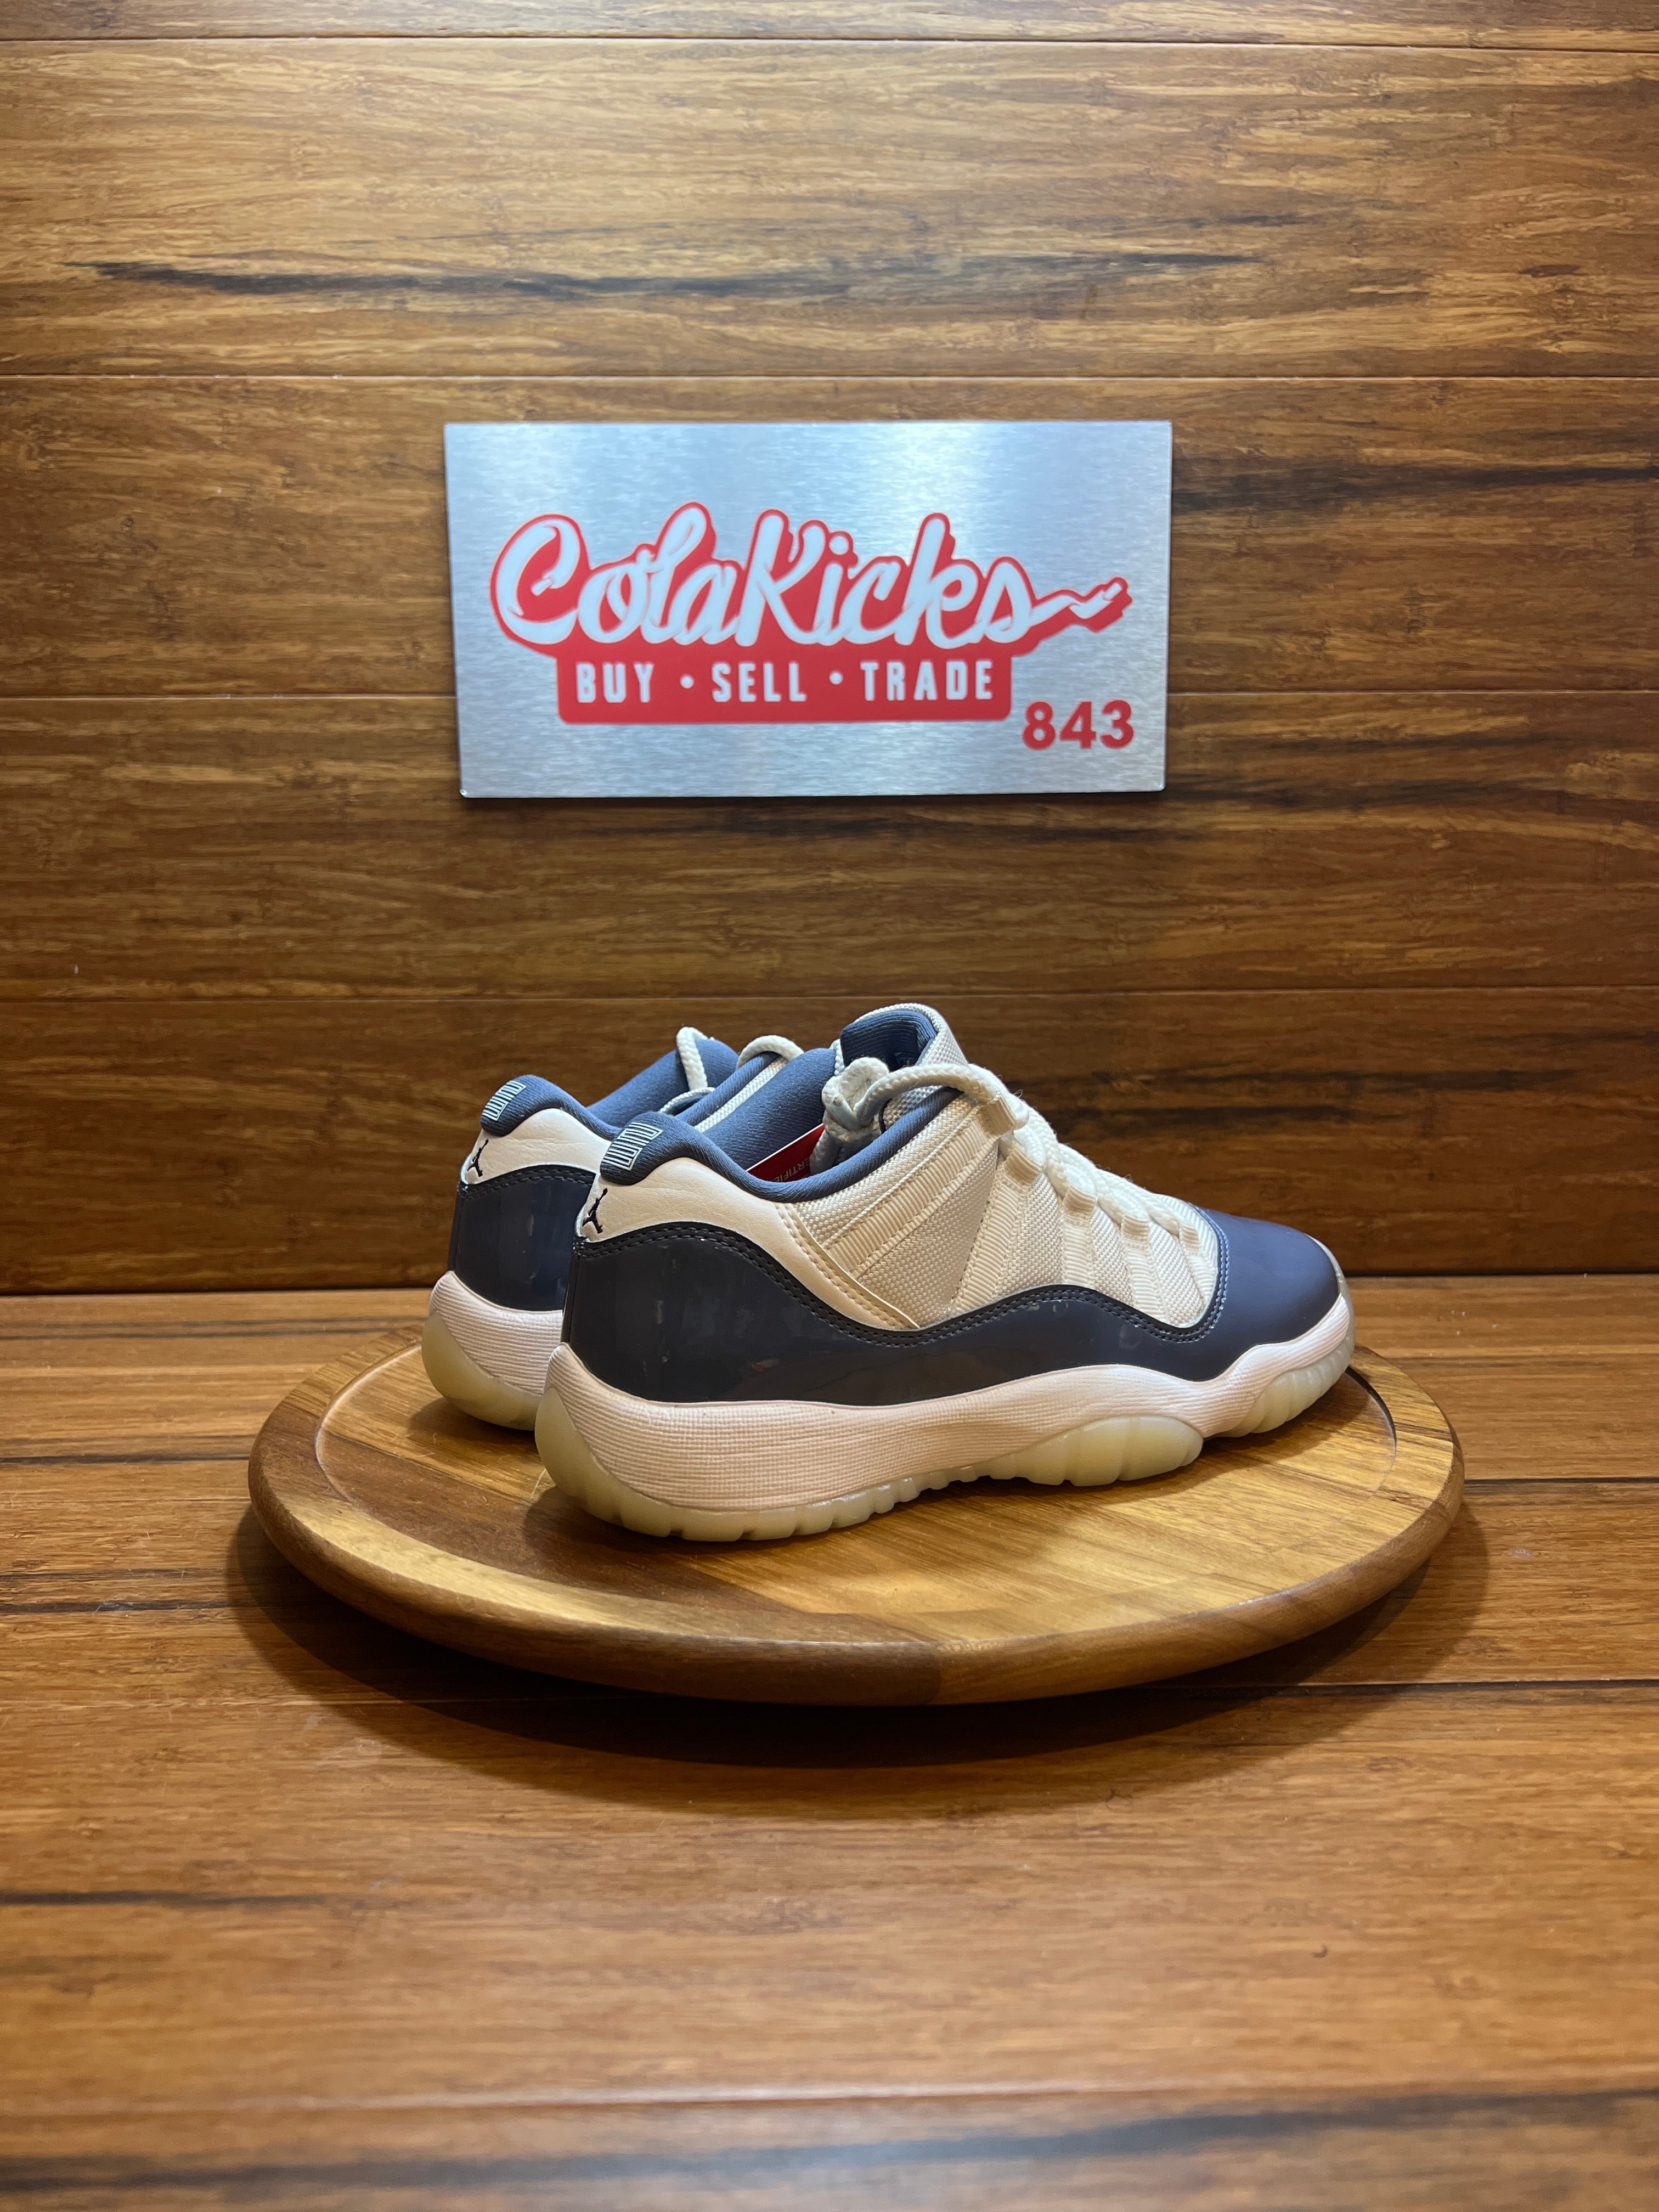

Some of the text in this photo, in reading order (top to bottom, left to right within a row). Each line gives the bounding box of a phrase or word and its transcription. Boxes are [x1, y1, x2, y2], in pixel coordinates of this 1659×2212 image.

[493, 504, 1126, 652] ColaKicks
[576, 659, 992, 703] BUY SELL TRADE
[1023, 700, 1133, 749] 843
